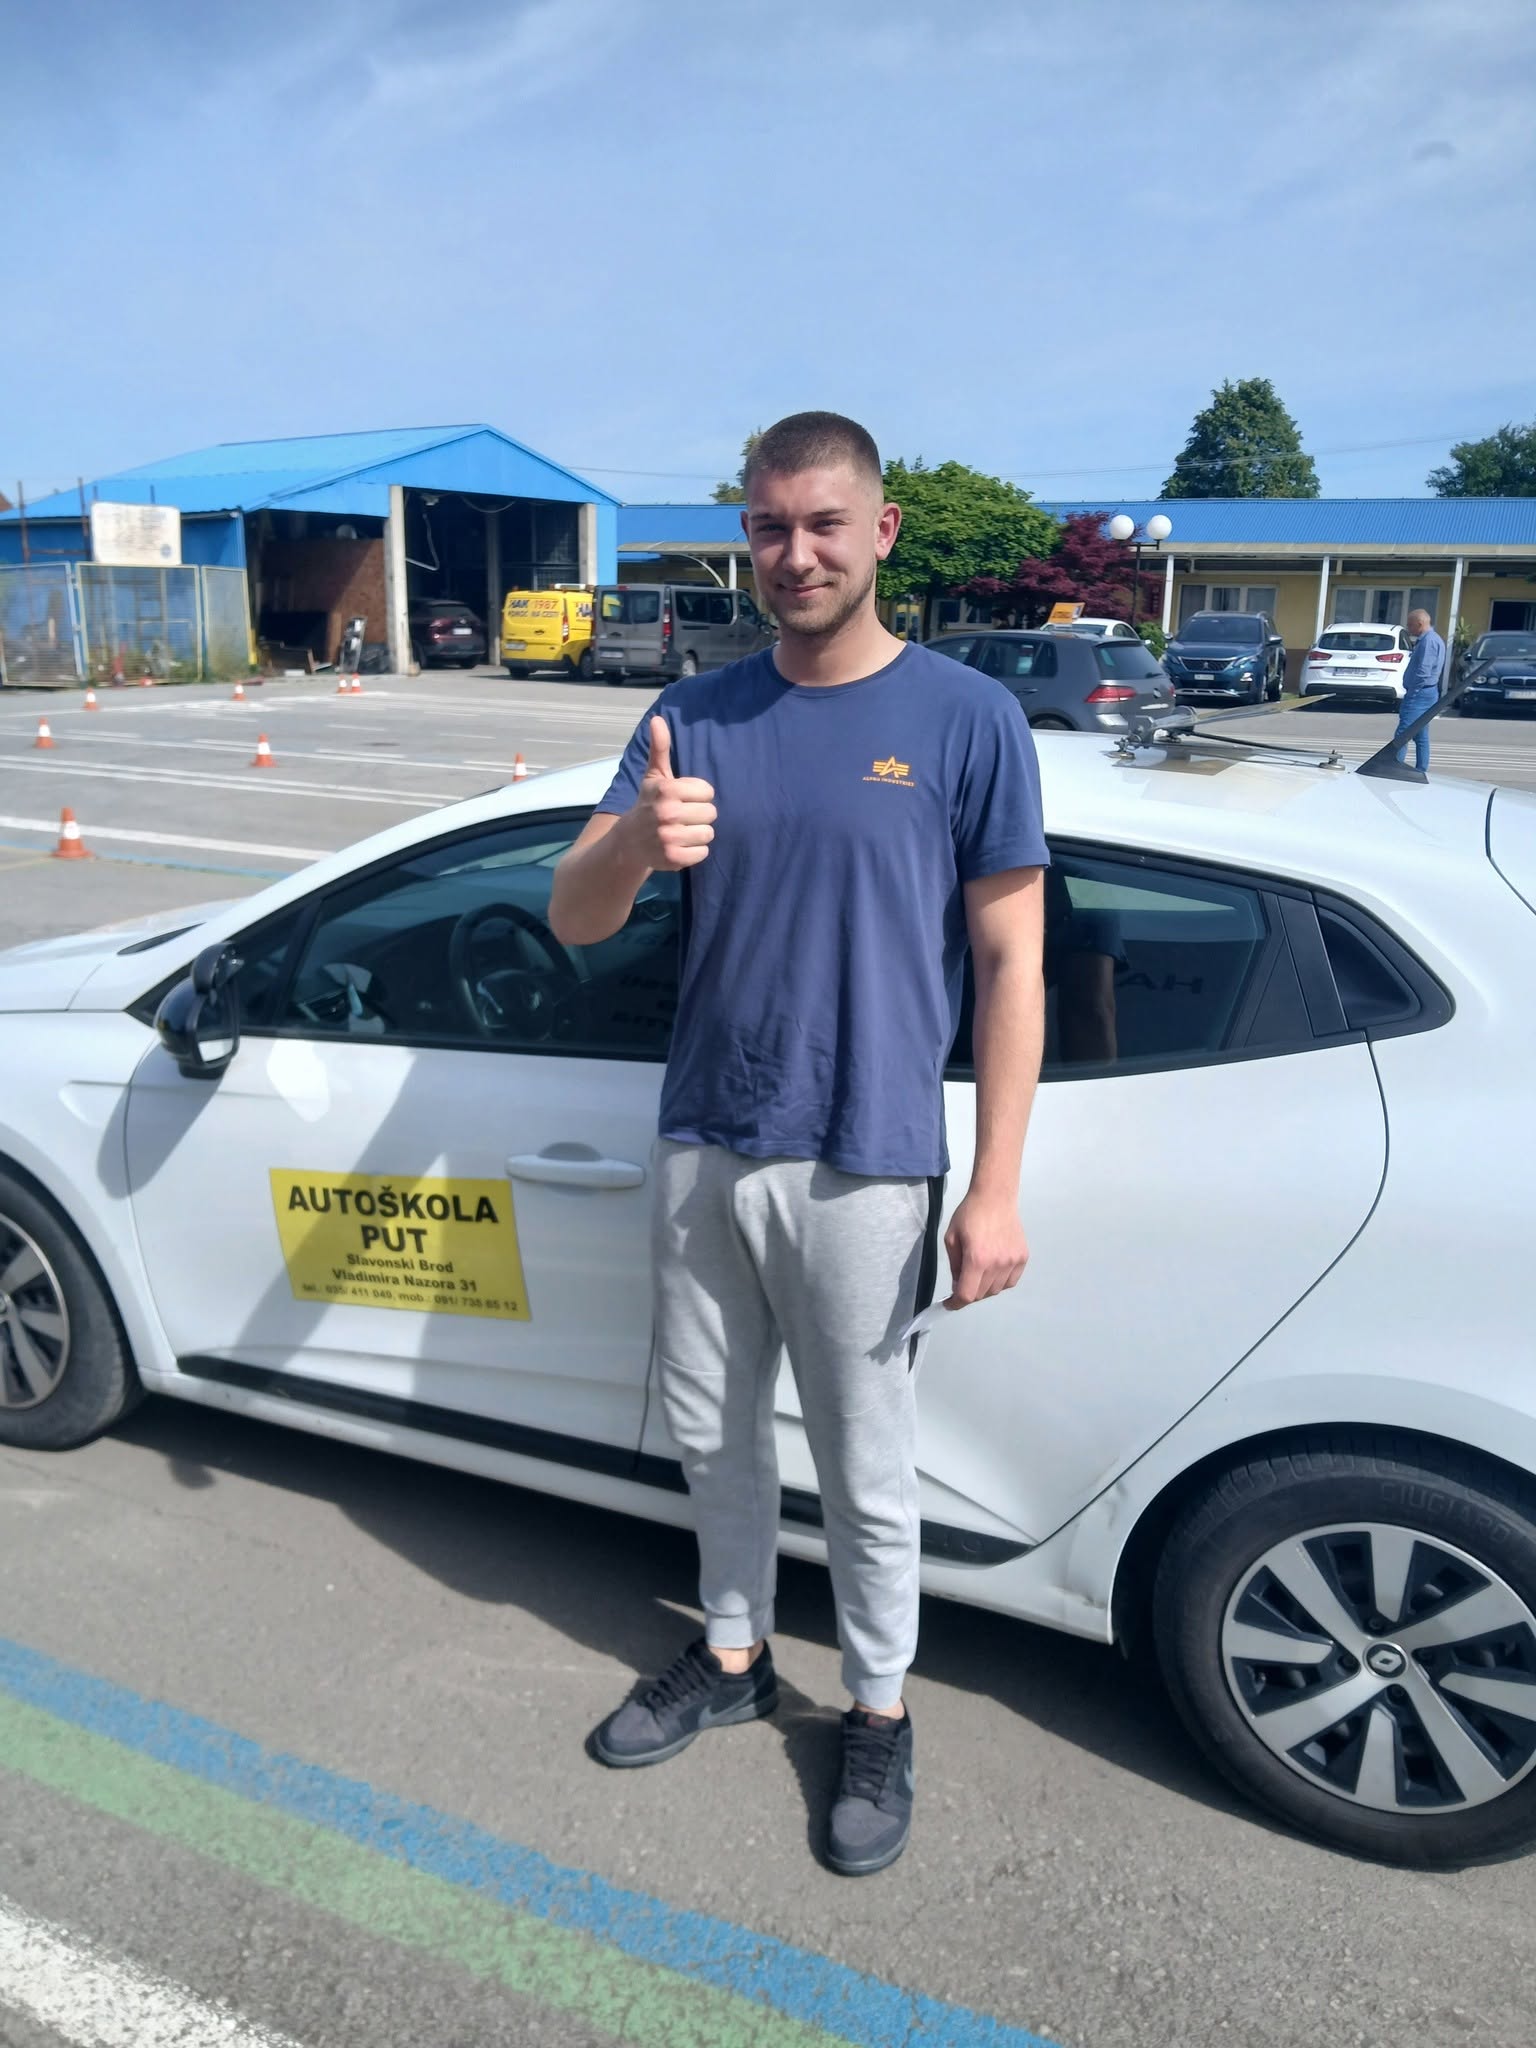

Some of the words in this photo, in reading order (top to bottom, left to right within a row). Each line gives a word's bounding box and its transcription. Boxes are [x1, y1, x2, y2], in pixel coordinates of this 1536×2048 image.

[534, 600, 558, 610] 1987
[289, 1185, 499, 1224] AUTOŠKOLA
[361, 1224, 427, 1253] PUT
[347, 1253, 414, 1270] Slavonski
[419, 1259, 454, 1273] Brod
[332, 1267, 400, 1286] Vladimira
[404, 1275, 456, 1291] Nazora
[460, 1278, 478, 1292] 31
[351, 1286, 369, 1298] 411
